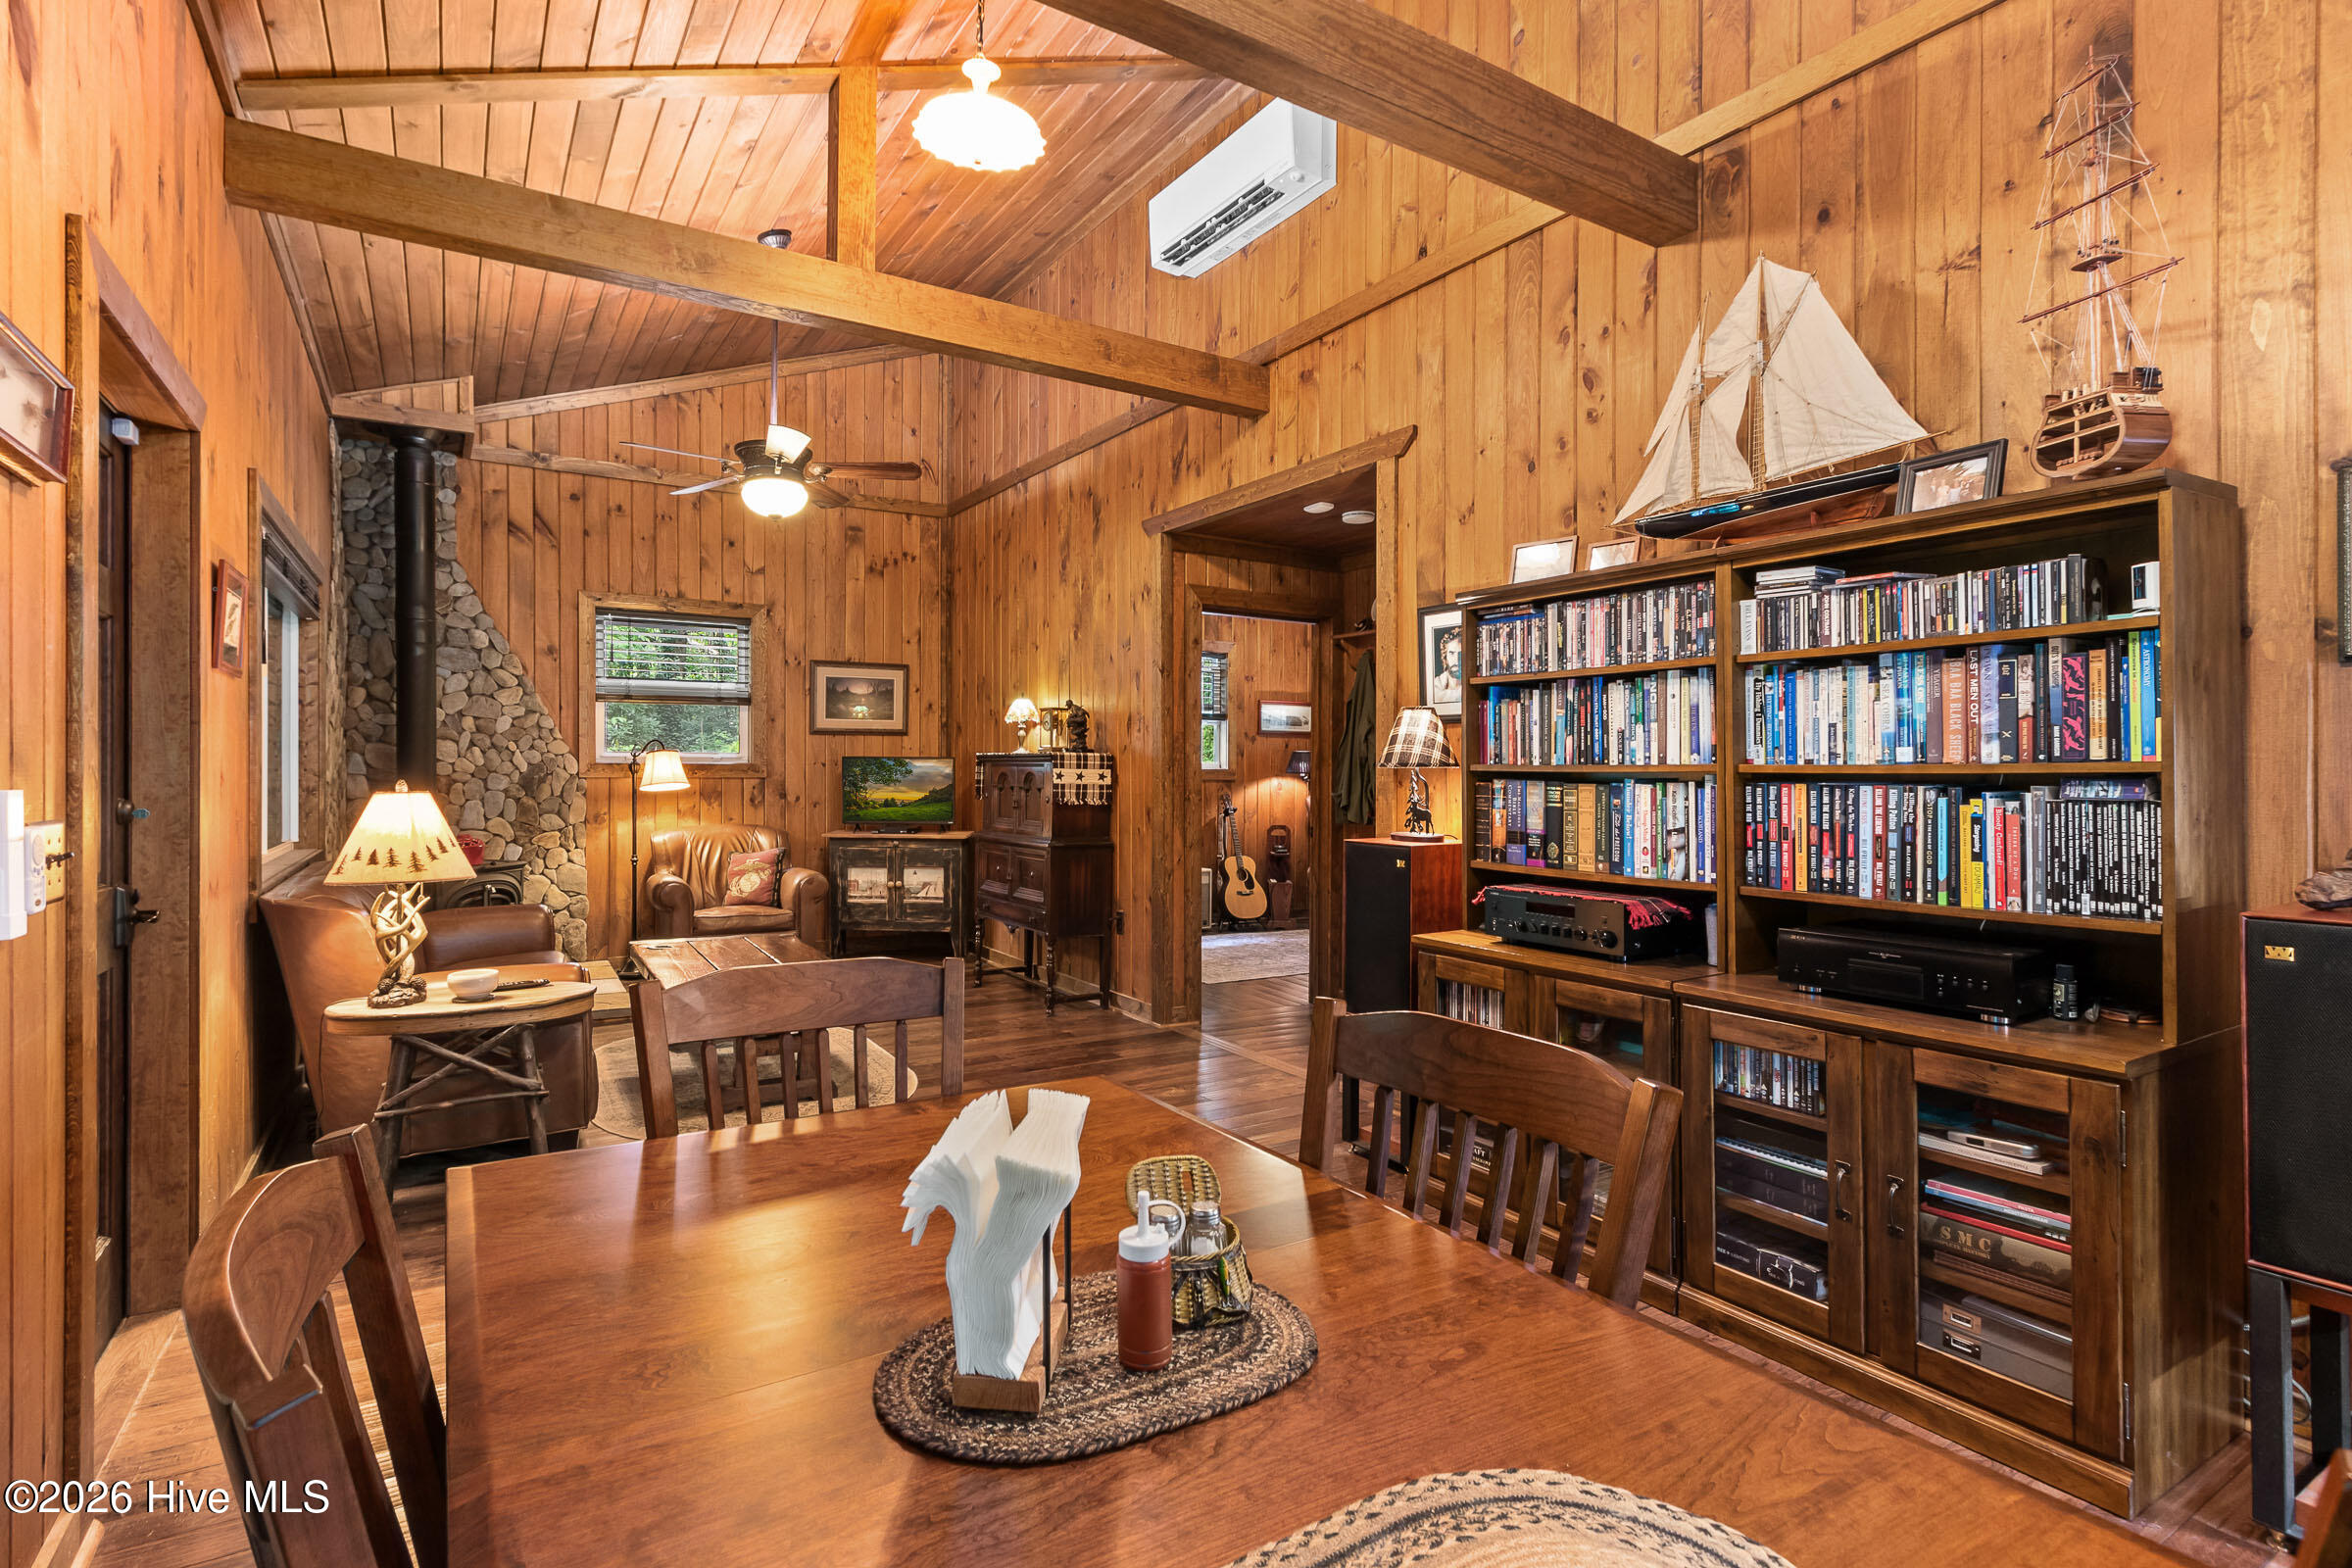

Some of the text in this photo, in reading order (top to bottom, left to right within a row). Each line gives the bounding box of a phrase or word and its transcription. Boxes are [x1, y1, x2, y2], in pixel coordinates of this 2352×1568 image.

[1949, 661, 1962, 760] BAA BAA BLACK SHEEP
[1970, 703, 1979, 724] OUT
[1846, 788, 1855, 805] Killing
[1888, 789, 1897, 808] Killing
[2018, 1204, 2034, 1213] PASTA
